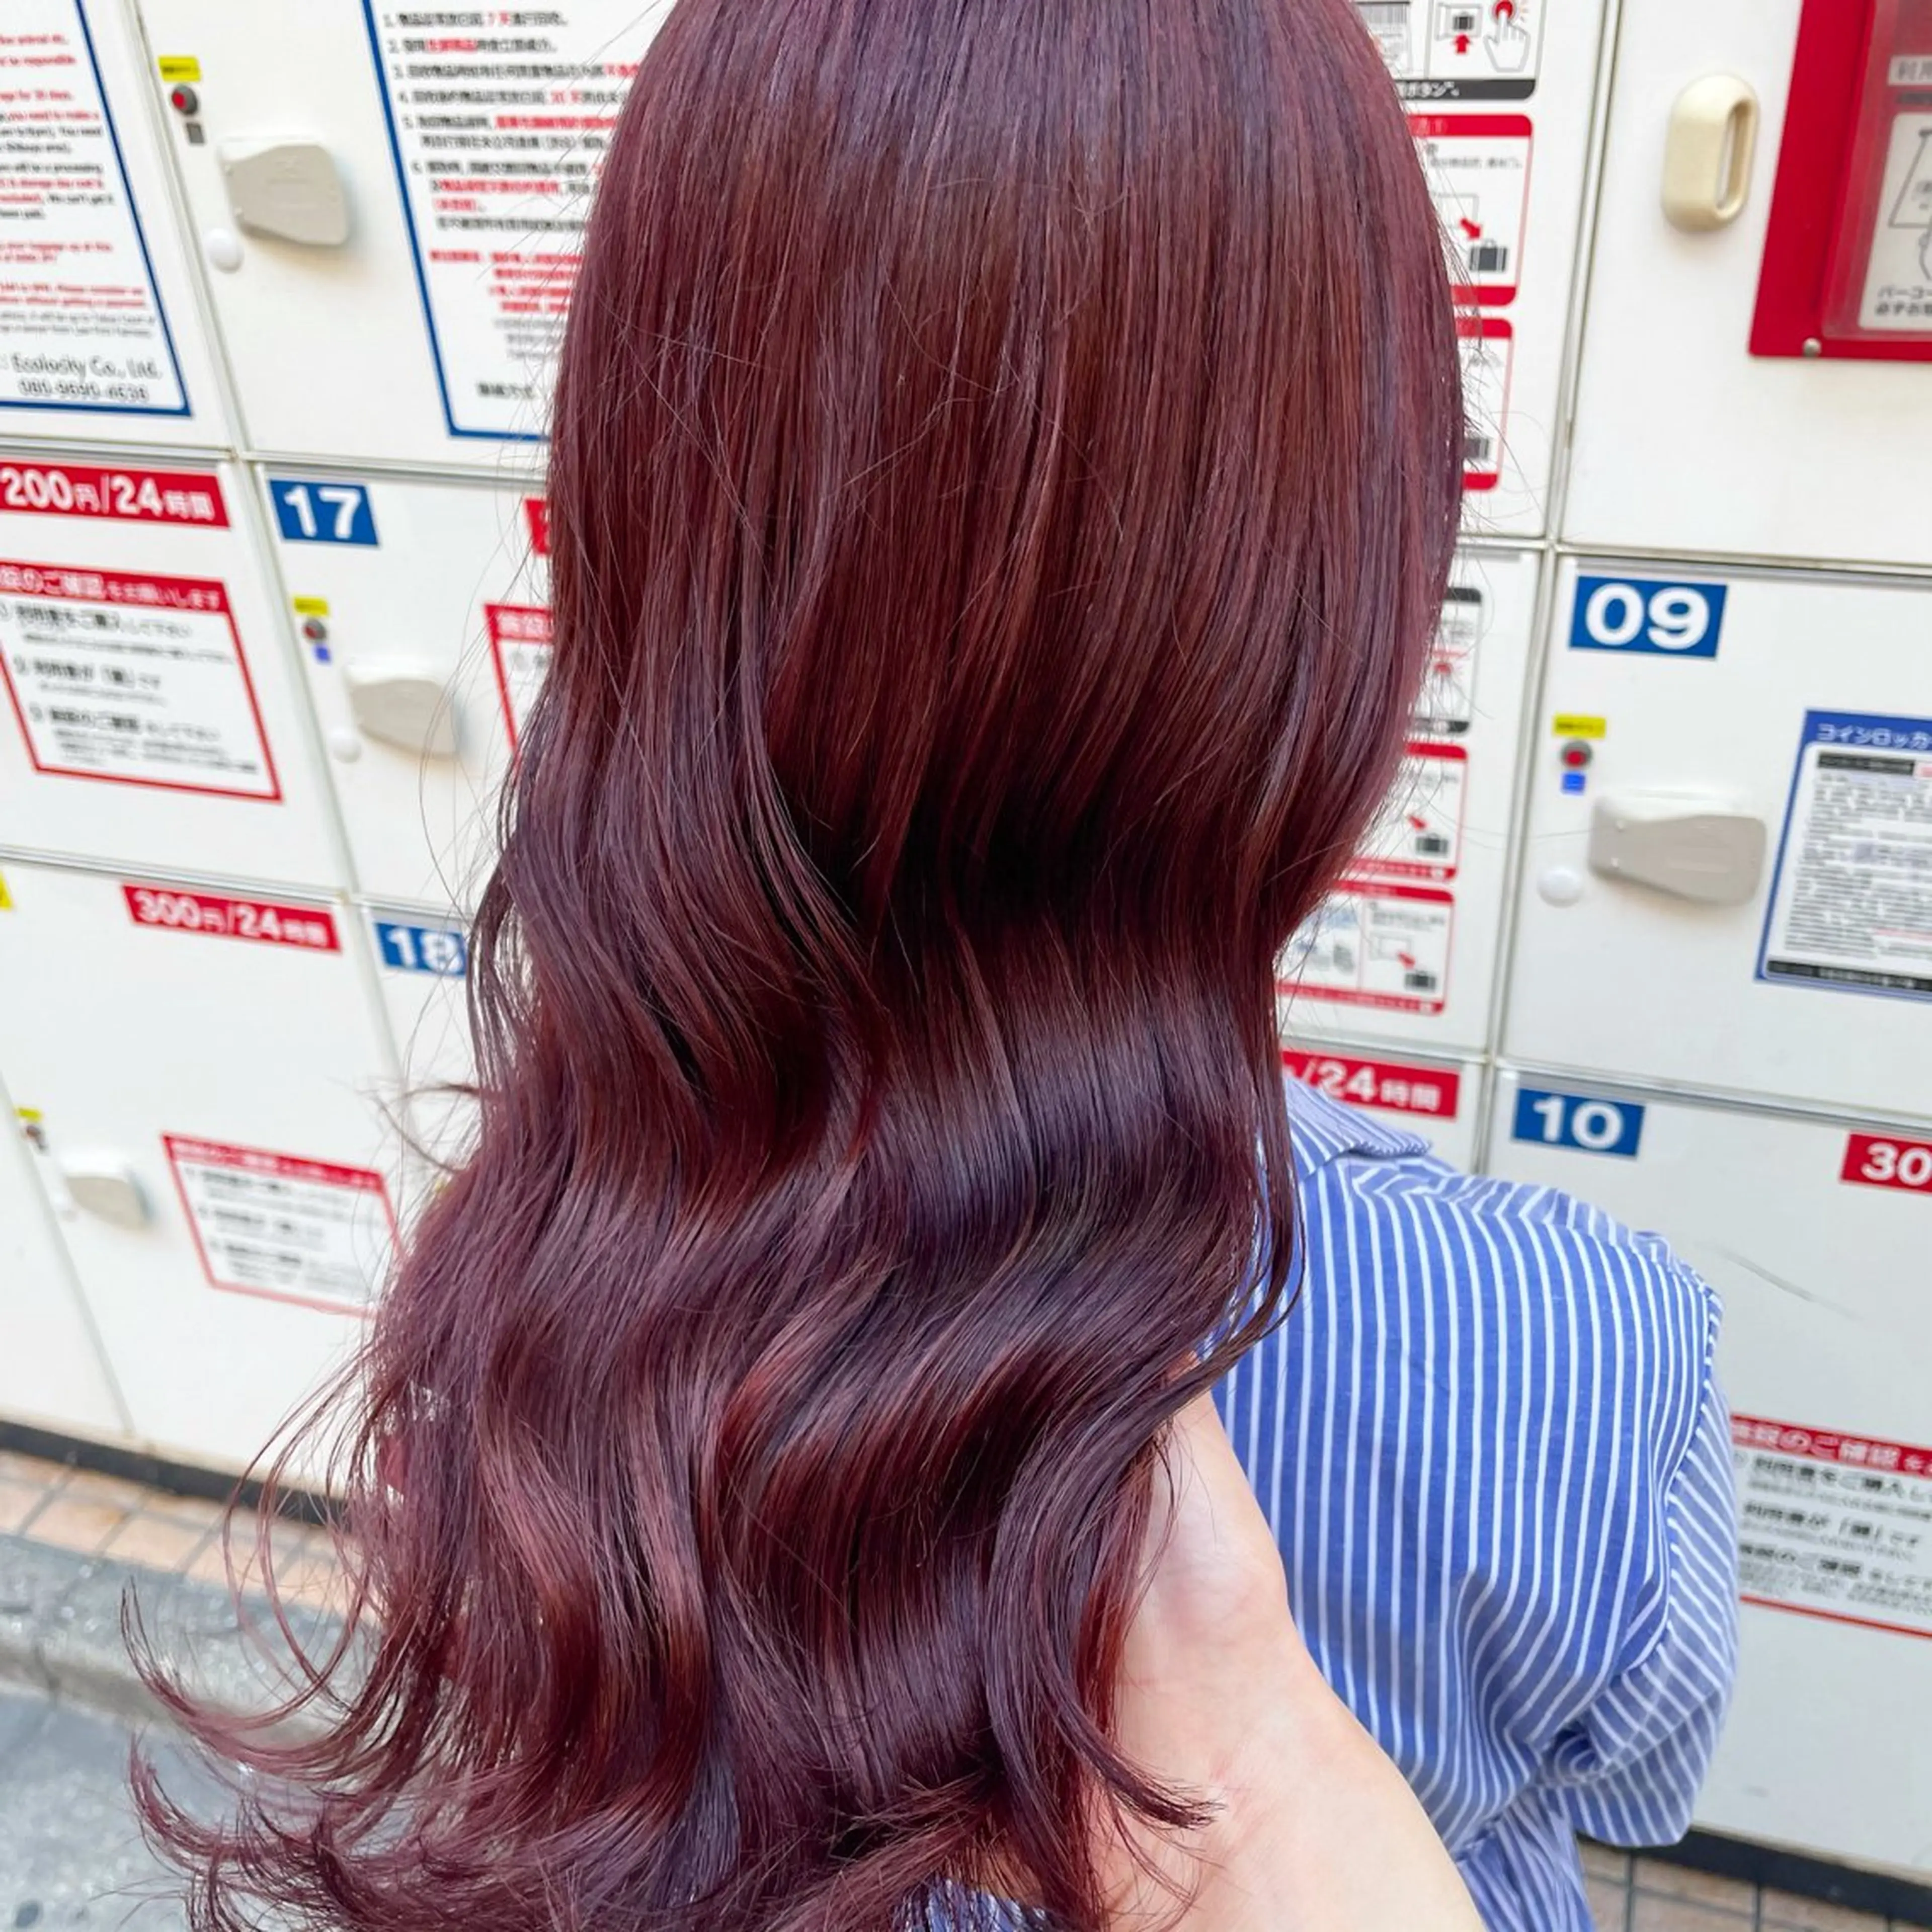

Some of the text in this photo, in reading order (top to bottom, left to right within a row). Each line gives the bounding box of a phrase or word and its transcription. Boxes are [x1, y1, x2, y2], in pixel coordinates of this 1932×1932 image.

[284, 485, 362, 539] 17
[1585, 582, 1710, 651] 09
[1817, 722, 1932, 750] コインロッカ
[386, 927, 463, 974] 18
[1533, 1095, 1624, 1151] 10
